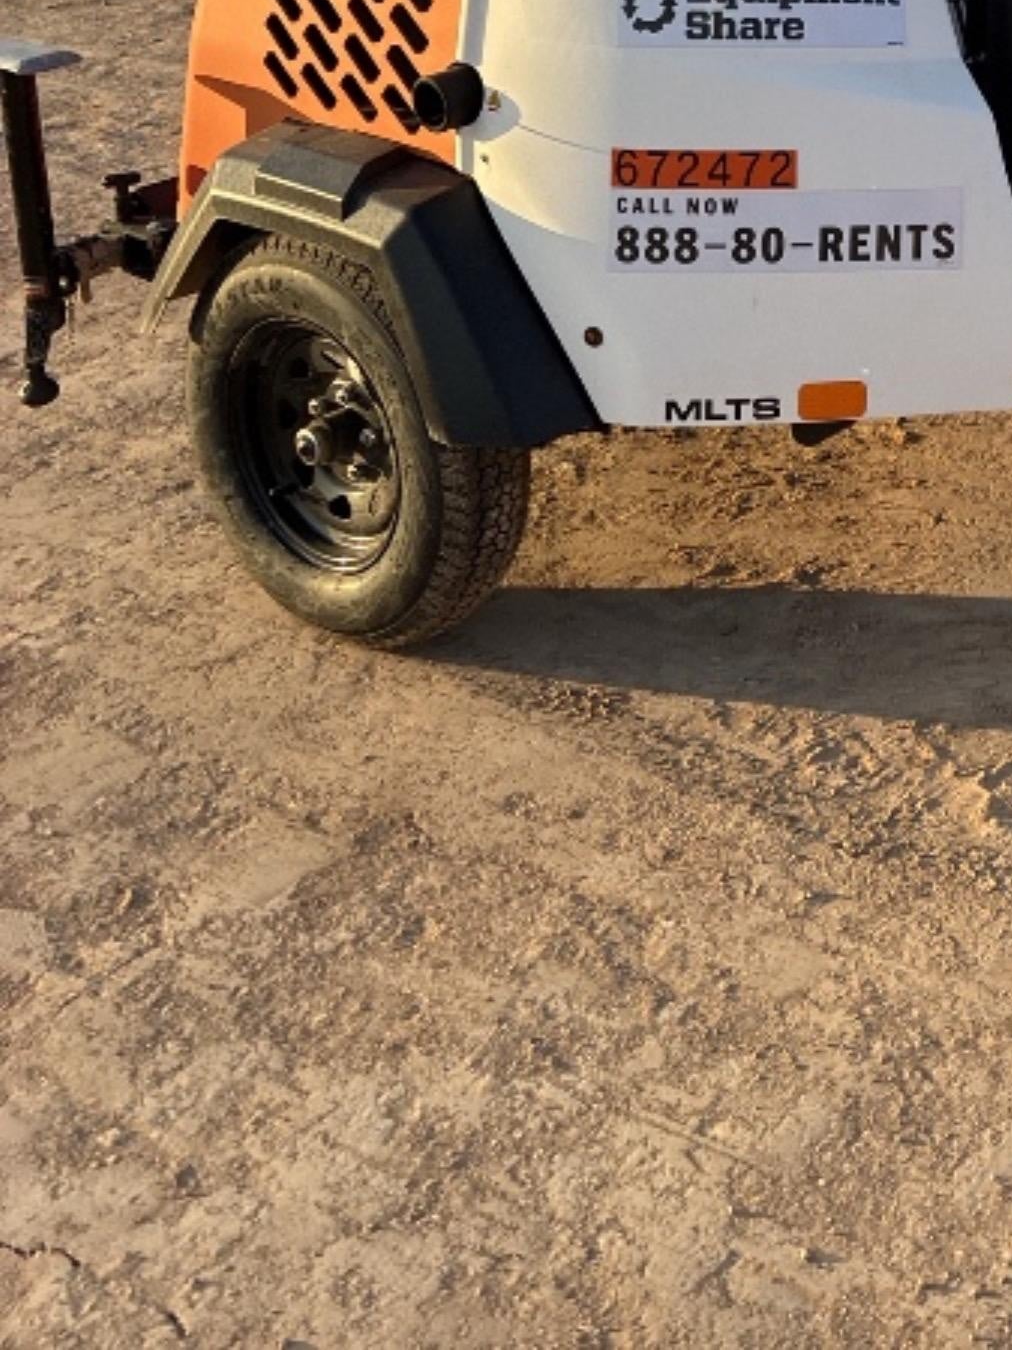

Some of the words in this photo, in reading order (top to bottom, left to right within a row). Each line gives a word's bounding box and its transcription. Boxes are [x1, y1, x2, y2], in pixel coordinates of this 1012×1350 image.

[685, 10, 805, 40] Share
[614, 150, 793, 188] 672472
[616, 197, 674, 215] CALL
[686, 197, 740, 214] NOW
[614, 223, 957, 266] 888-80-RENTS
[664, 398, 781, 422] MLTS
